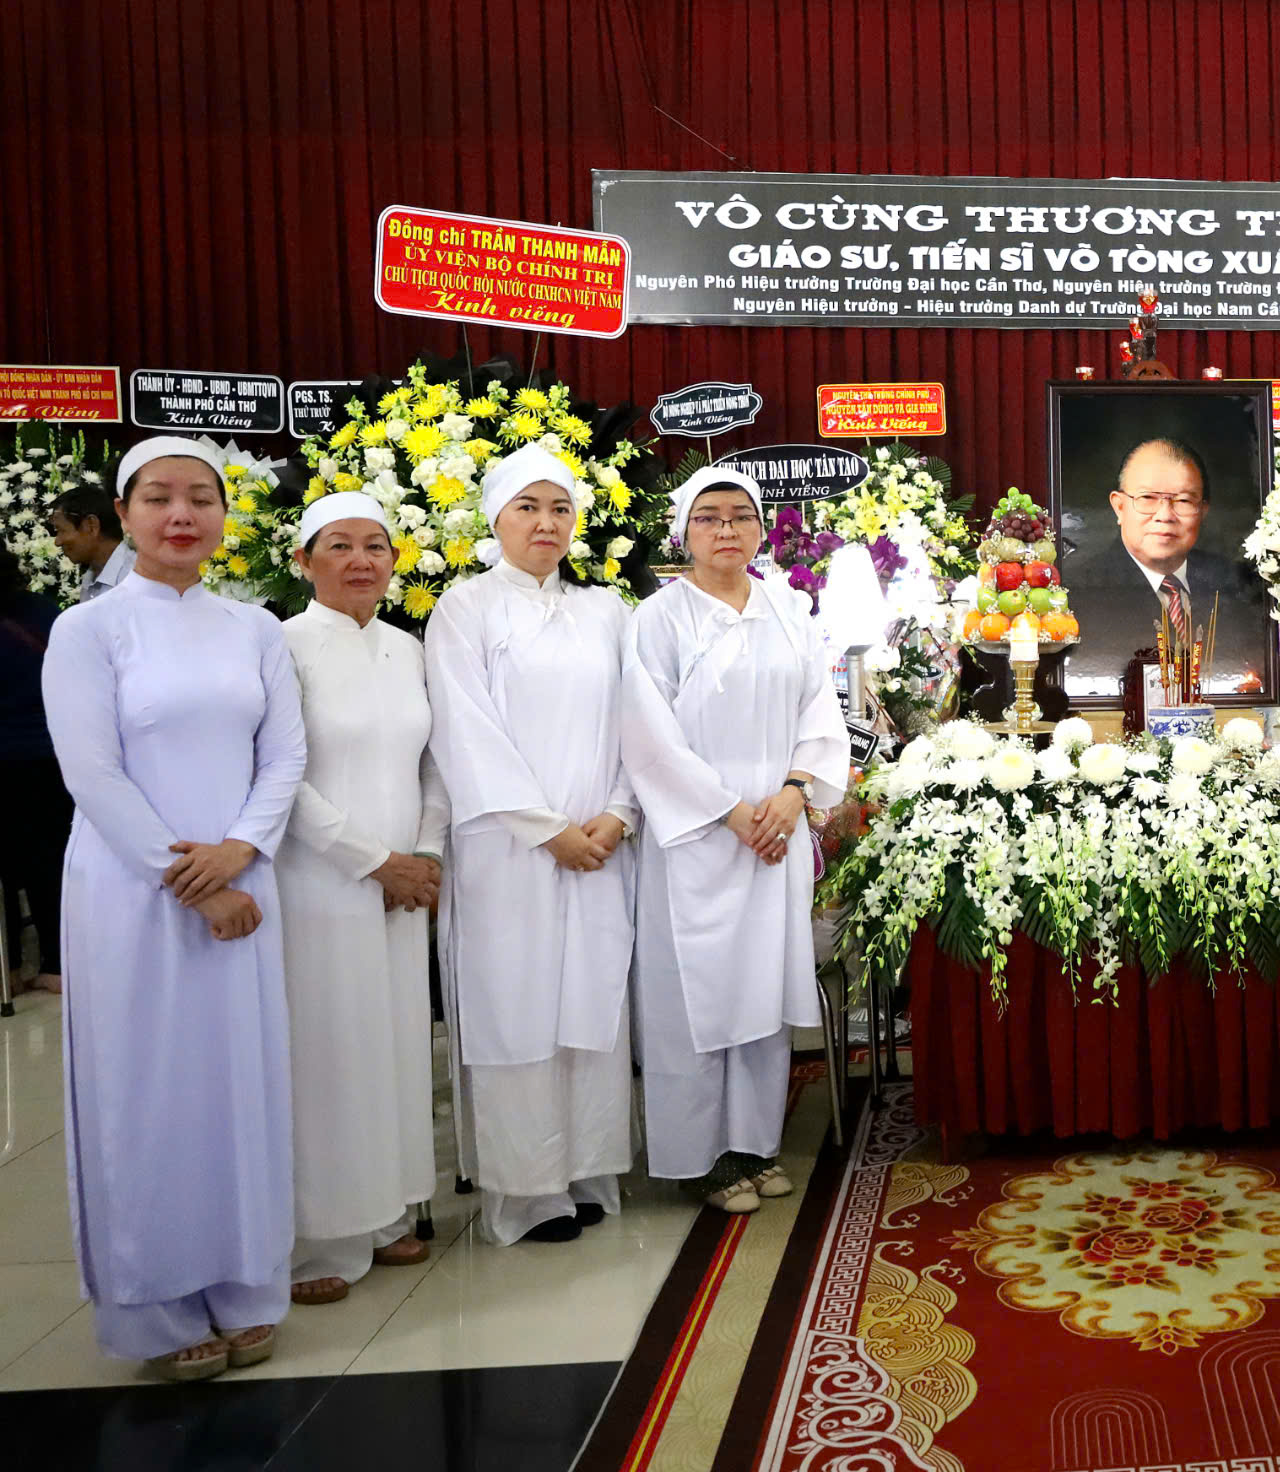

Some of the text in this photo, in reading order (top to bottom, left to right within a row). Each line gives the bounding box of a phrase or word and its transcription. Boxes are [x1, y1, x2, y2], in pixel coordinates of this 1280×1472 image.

[675, 193, 762, 229] VÔ
[775, 195, 949, 232] CÙNG
[965, 204, 1220, 236] THƯƠNG
[389, 218, 620, 266] Đồng chí TRẦN THANH MẪN
[729, 239, 831, 269] GIÁO
[841, 244, 900, 272] SƯ,
[909, 238, 990, 270] TIẾN
[1000, 241, 1034, 271] SĨ
[1043, 242, 1100, 272] VÕ
[1109, 244, 1213, 273] TÒNG
[405, 242, 614, 289] ỦY VIÊN BỘ CHÍNH TRỊ
[385, 262, 622, 310] CHỦ TỊCH QUỐC HỘI NƯỚC CHXHCN VIỆT NAM
[635, 275, 698, 290] Nguyên
[704, 275, 735, 288] Phó
[742, 275, 779, 292] Hiệu
[785, 276, 839, 292] trưởng
[845, 276, 902, 292] Trường
[907, 278, 935, 294] Đại
[940, 278, 970, 294] học
[975, 277, 1008, 292] Cần
[1012, 278, 1047, 294] Thơ,
[1053, 279, 1112, 295] Nguyên
[1118, 280, 1153, 293] Hiệu
[1159, 280, 1211, 296] trưởng
[1216, 280, 1272, 296] Trường
[425, 290, 575, 328] Kính viếng
[734, 297, 795, 313] Nguyên
[801, 298, 839, 314] Hiệu
[844, 298, 898, 314] trưởng
[917, 299, 954, 316] Hiệu
[959, 299, 1013, 315] trưởng
[1019, 300, 1060, 314] Danh
[1065, 300, 1086, 316] dự
[1090, 300, 1142, 316] Trường
[1183, 302, 1212, 318] học
[1218, 303, 1253, 316] Nam
[137, 373, 277, 398] THÀNH ỦY HĐND UBND UBMTTQVN
[295, 390, 333, 403] PGS. TS.
[160, 395, 191, 409] THÀNH
[195, 396, 214, 410] PHỐ
[238, 400, 256, 412] THƠ
[164, 412, 253, 428] Kính Viếng
[769, 453, 859, 486] ĐẠI HỌC TÂN TẠO
[790, 483, 829, 497] VIẾNG
